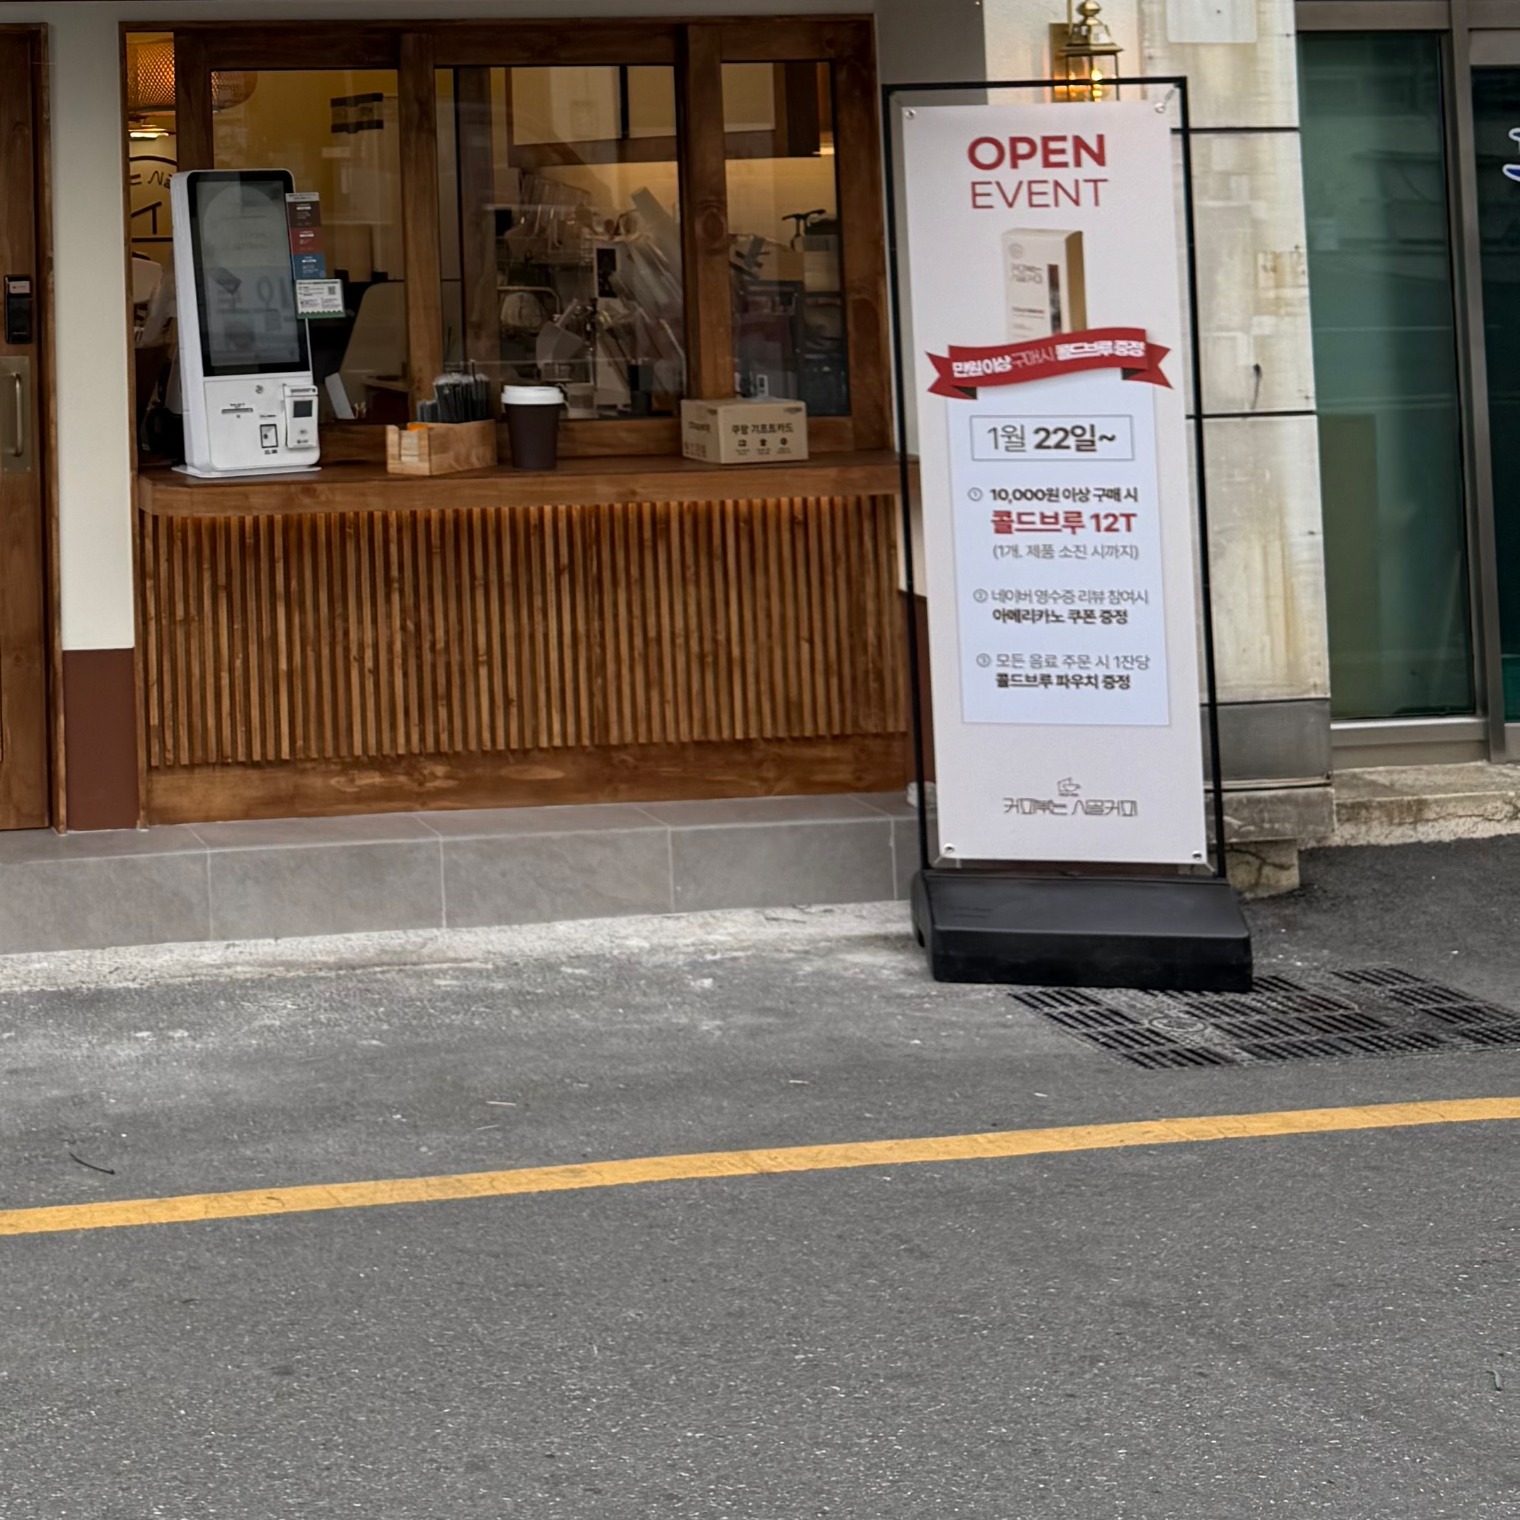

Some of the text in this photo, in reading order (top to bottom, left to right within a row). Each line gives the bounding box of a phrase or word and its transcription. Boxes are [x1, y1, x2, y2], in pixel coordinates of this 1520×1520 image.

[967, 134, 1107, 170] OPEN
[970, 179, 1109, 210] EVENT
[987, 424, 1116, 453] 1월 22일~
[990, 488, 1060, 504] 10,000원
[1062, 487, 1091, 503] 이상
[1093, 487, 1122, 503] 구매
[1123, 487, 1139, 503] 시
[991, 510, 1138, 535] 콜드브루 12T
[1058, 544, 1089, 560] 소진
[991, 589, 1033, 605] 네이버
[1034, 589, 1076, 605] 영수증
[1077, 589, 1106, 605] 리뷰
[992, 608, 1129, 625] 아메리카노 쿠폰 증정
[995, 653, 1025, 669] 모든
[1029, 654, 1060, 670] 음료
[1062, 654, 1092, 670] 주문
[1095, 654, 1110, 670] 시
[1113, 654, 1151, 670] 1잔당
[995, 673, 1054, 689] 콜드브루
[1101, 674, 1132, 689] 증정
